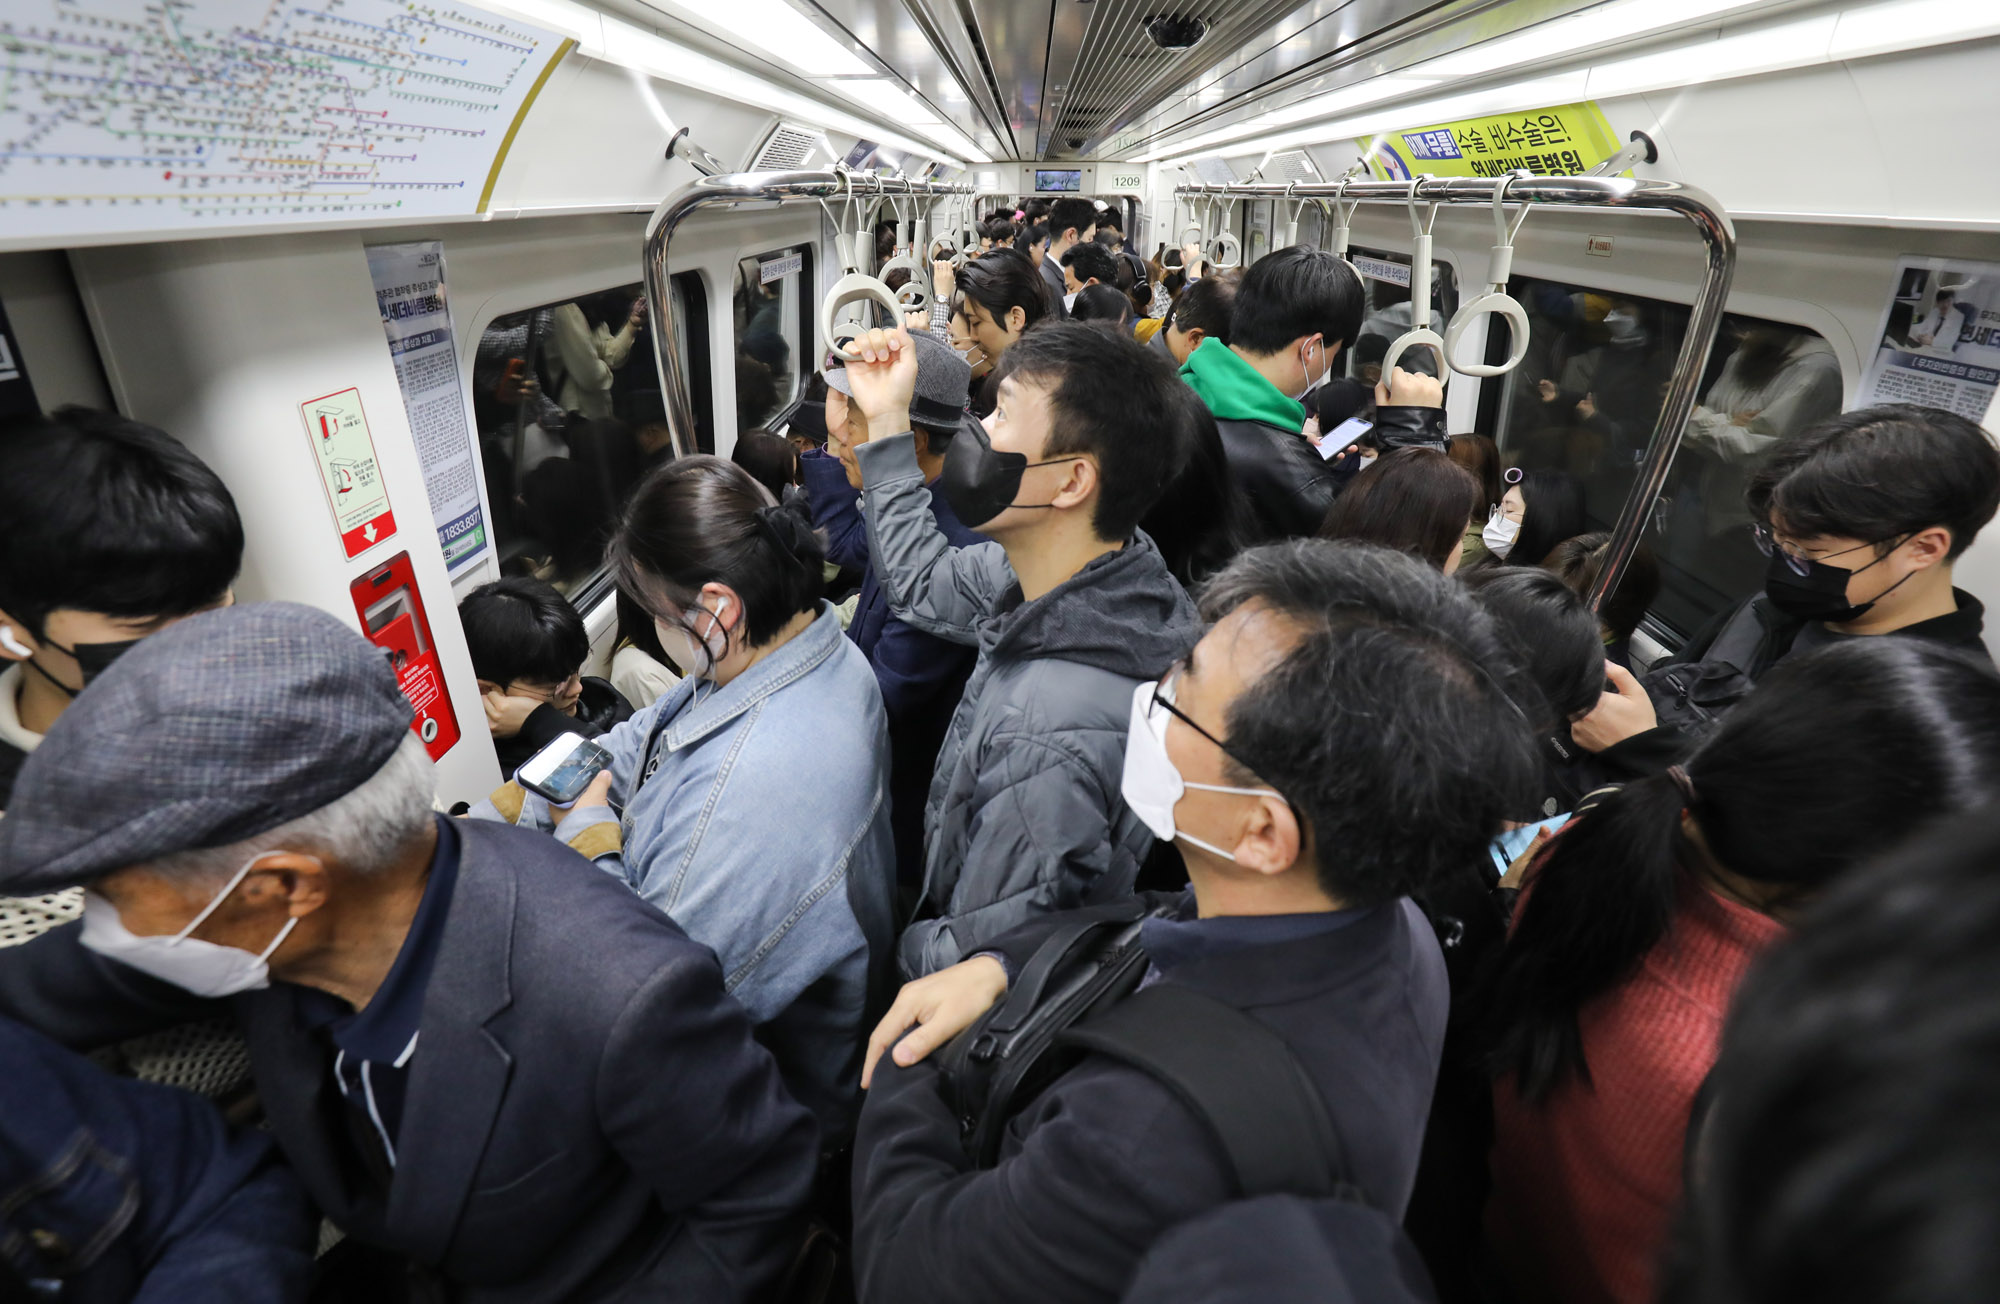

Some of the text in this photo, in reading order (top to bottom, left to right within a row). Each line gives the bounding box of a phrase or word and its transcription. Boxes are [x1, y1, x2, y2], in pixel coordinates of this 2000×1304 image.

[1458, 127, 1493, 155] 수술,
[1115, 176, 1140, 187] 1209
[444, 510, 480, 540] 1833.8371
